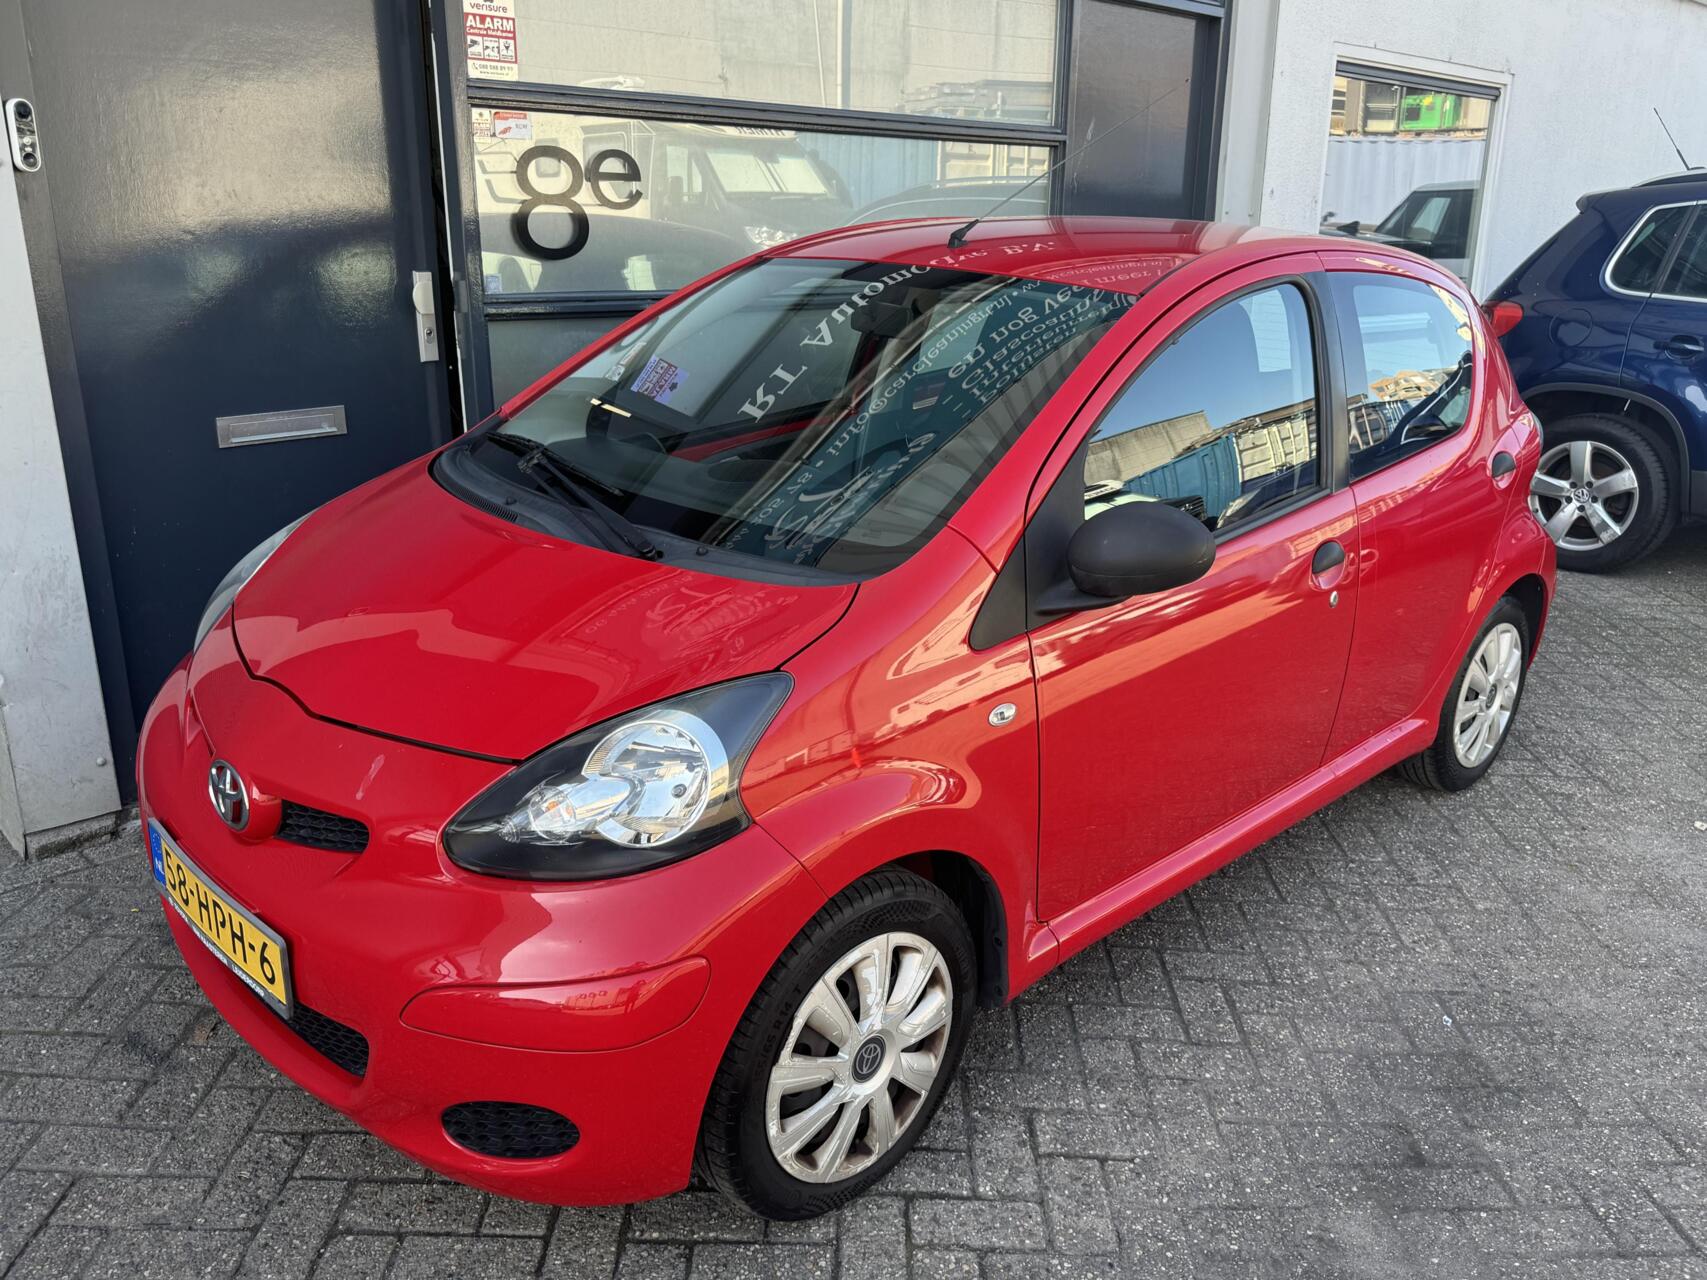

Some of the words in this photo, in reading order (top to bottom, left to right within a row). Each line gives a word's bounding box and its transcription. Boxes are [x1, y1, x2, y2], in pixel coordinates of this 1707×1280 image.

[469, 2, 508, 13] verisure
[466, 14, 514, 32] ALARM
[154, 858, 165, 876] NL
[164, 847, 276, 985] 58-HPH-6
